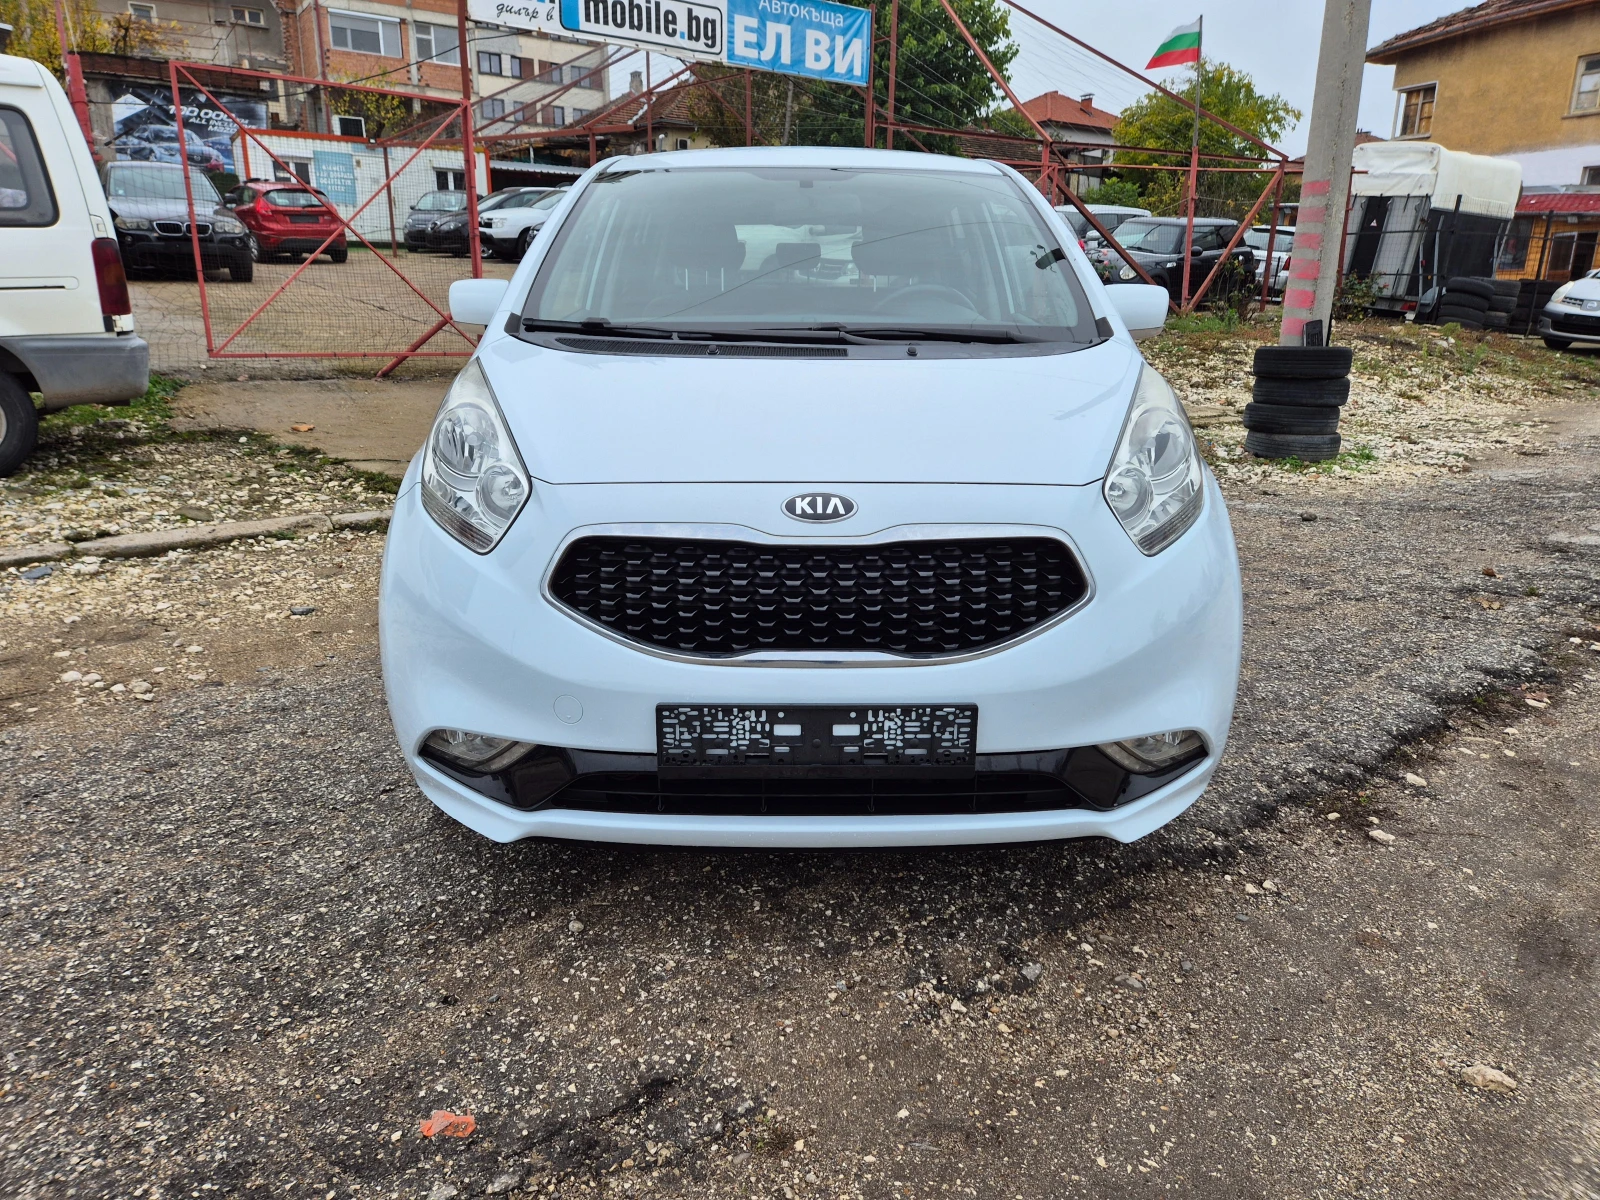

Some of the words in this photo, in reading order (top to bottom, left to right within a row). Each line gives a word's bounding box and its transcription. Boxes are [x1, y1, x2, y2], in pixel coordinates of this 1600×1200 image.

[496, 3, 539, 22] дилър
[584, 0, 717, 49] mobile.bg
[758, 0, 844, 29] Автокъща
[733, 14, 792, 66] ЕЛ
[805, 29, 863, 77] ВИ
[188, 117, 207, 125] ALL
[795, 496, 845, 515] KIA
